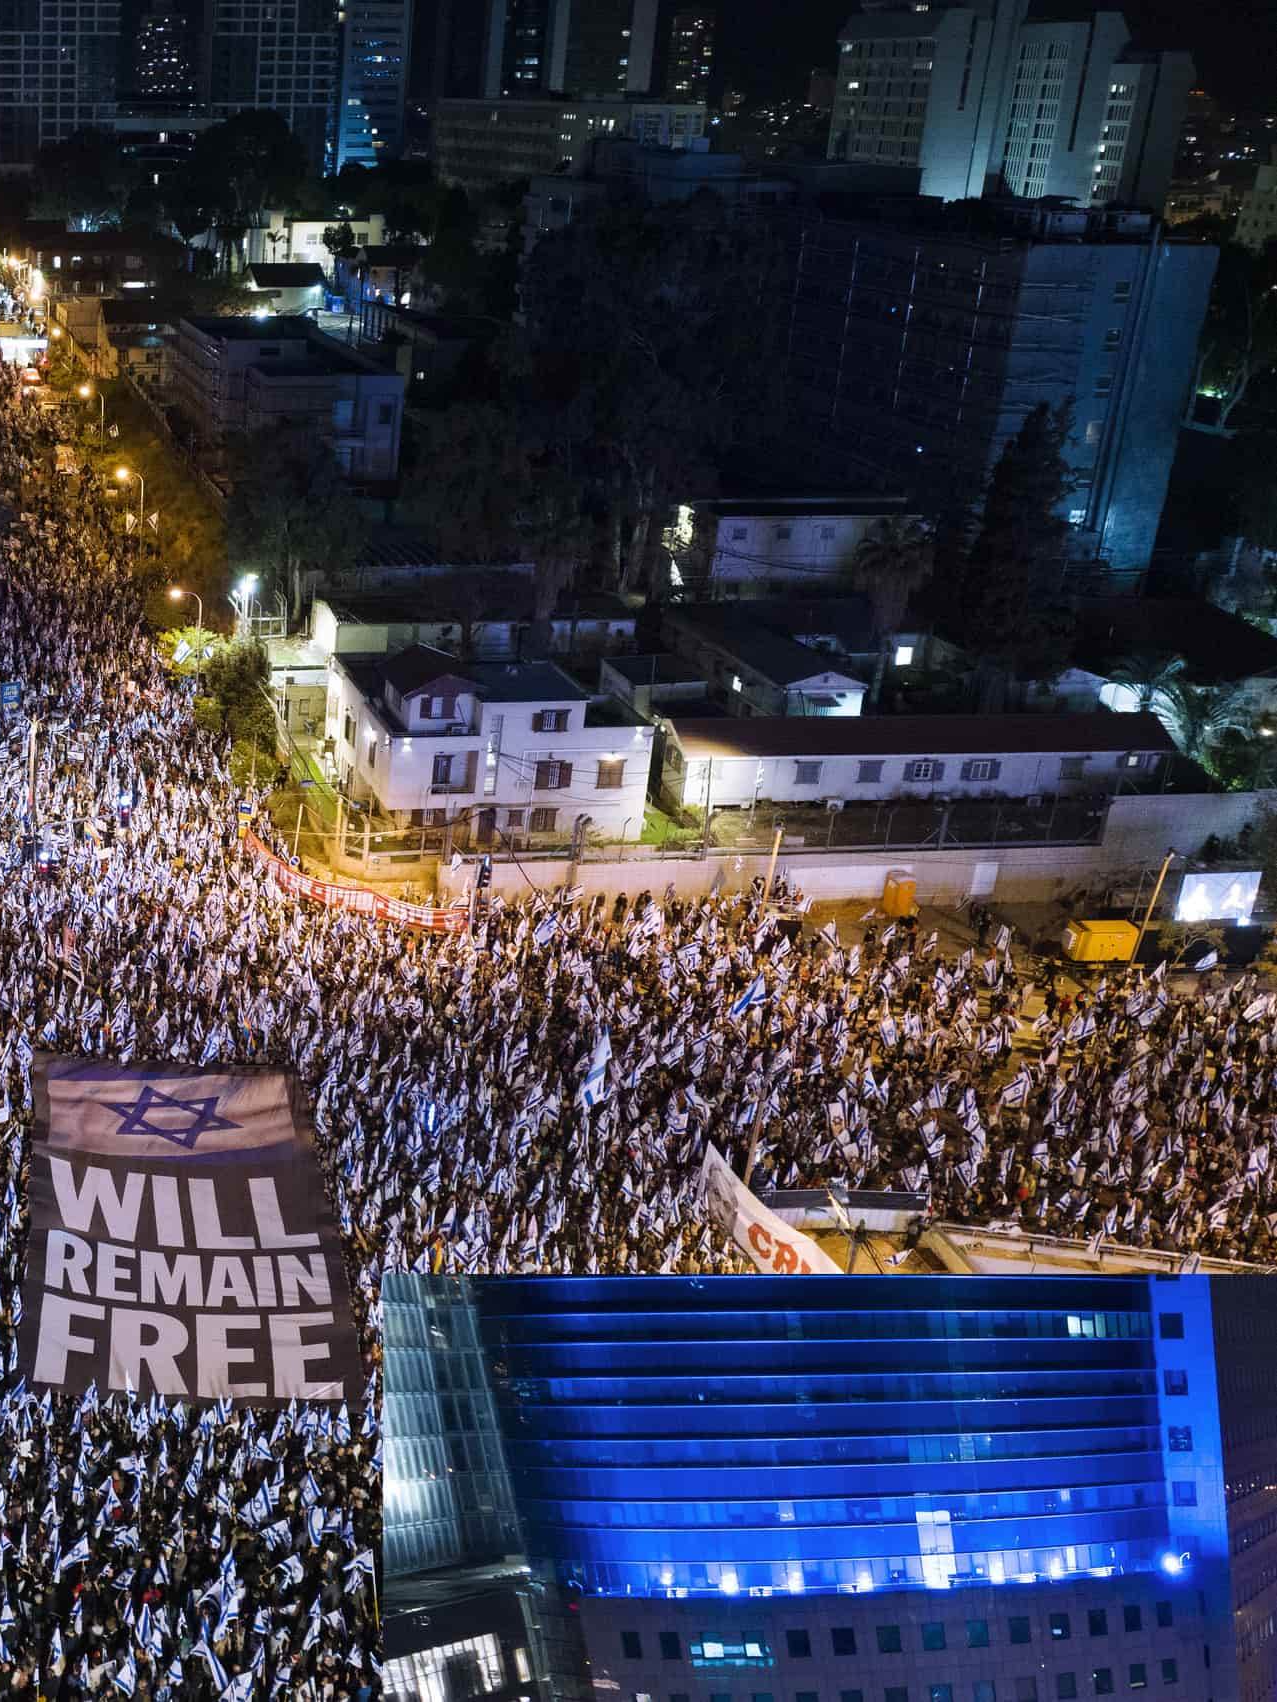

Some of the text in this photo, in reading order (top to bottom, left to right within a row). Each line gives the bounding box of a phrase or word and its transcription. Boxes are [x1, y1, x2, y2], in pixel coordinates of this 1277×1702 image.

[48, 1155, 321, 1250] WILL
[43, 1229, 332, 1308] REMAIN
[32, 1292, 344, 1400] FREE
